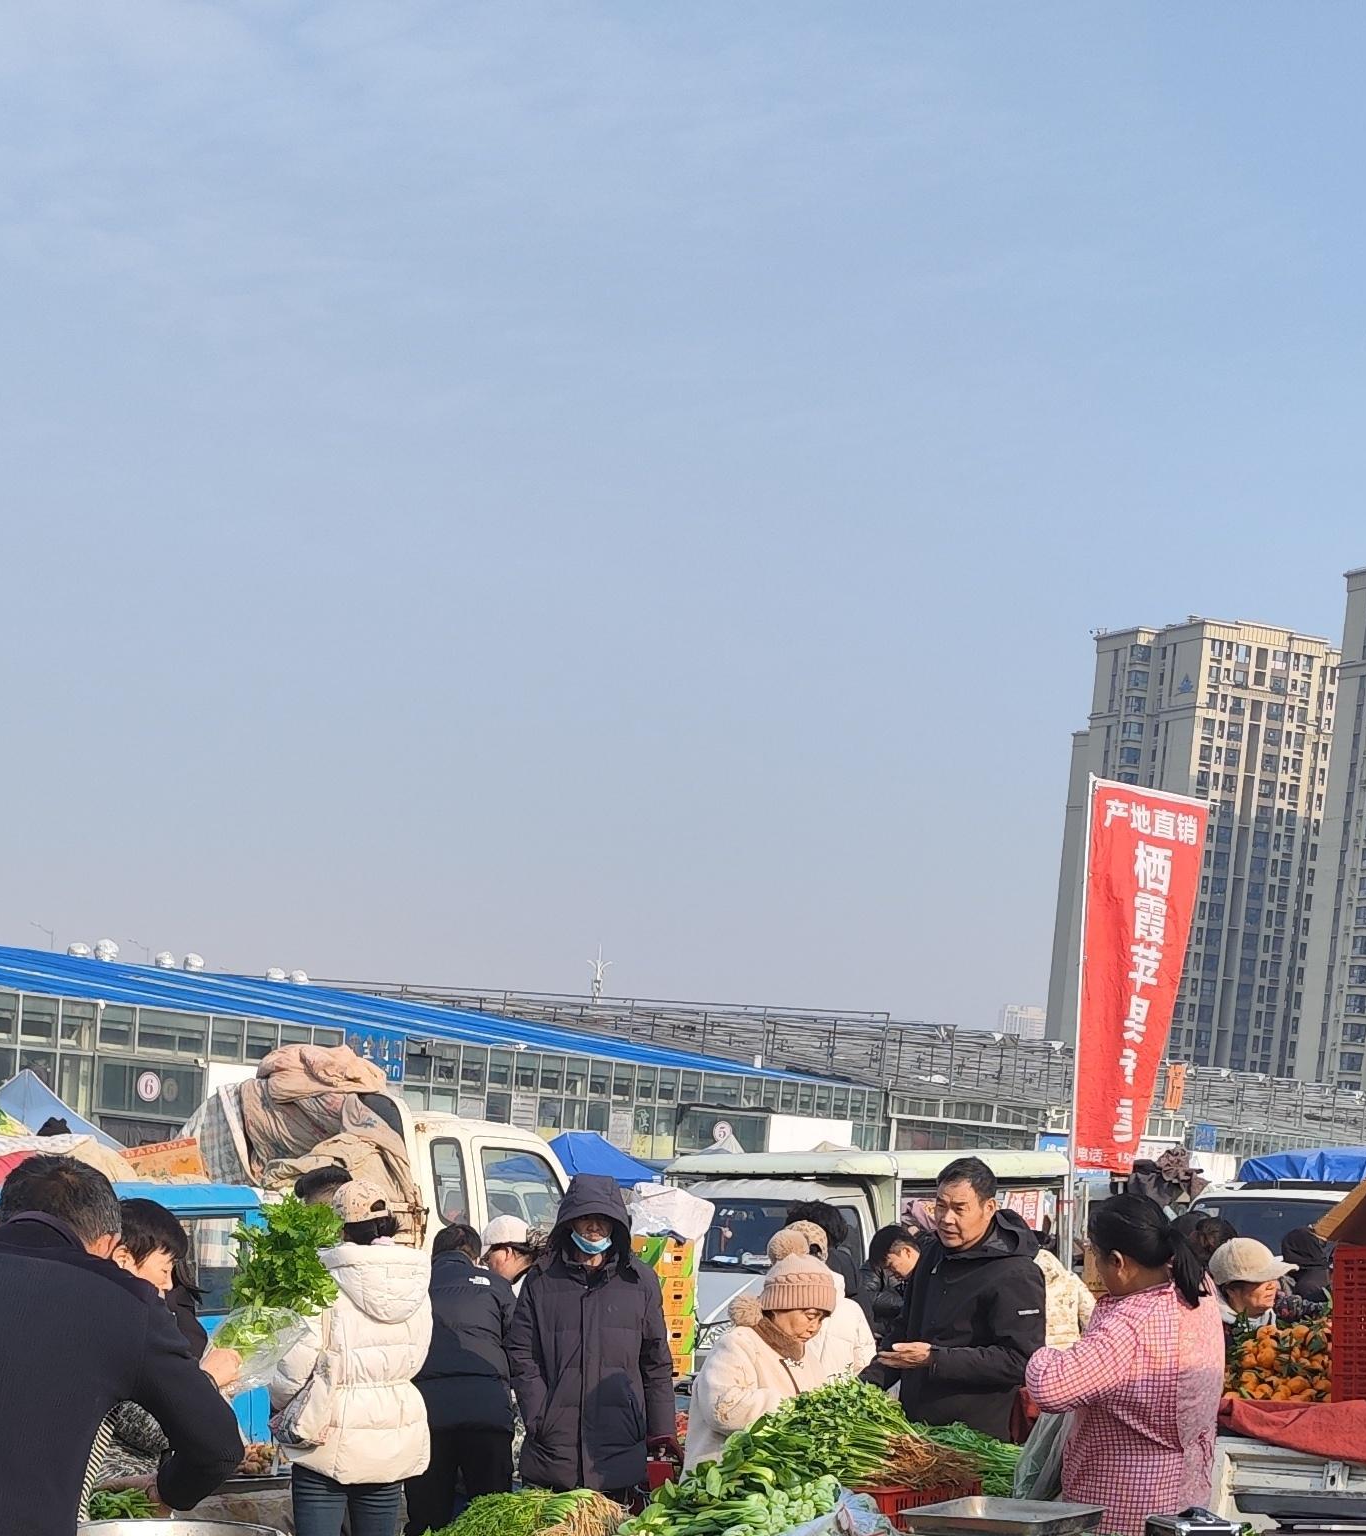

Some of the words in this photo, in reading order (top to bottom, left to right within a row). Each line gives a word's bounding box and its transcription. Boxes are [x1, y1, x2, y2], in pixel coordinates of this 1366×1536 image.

[1103, 798, 1199, 846] 产地直销
[144, 1078, 154, 1095] 6
[718, 1126, 727, 1139] 5
[125, 1140, 188, 1158] BANANA
